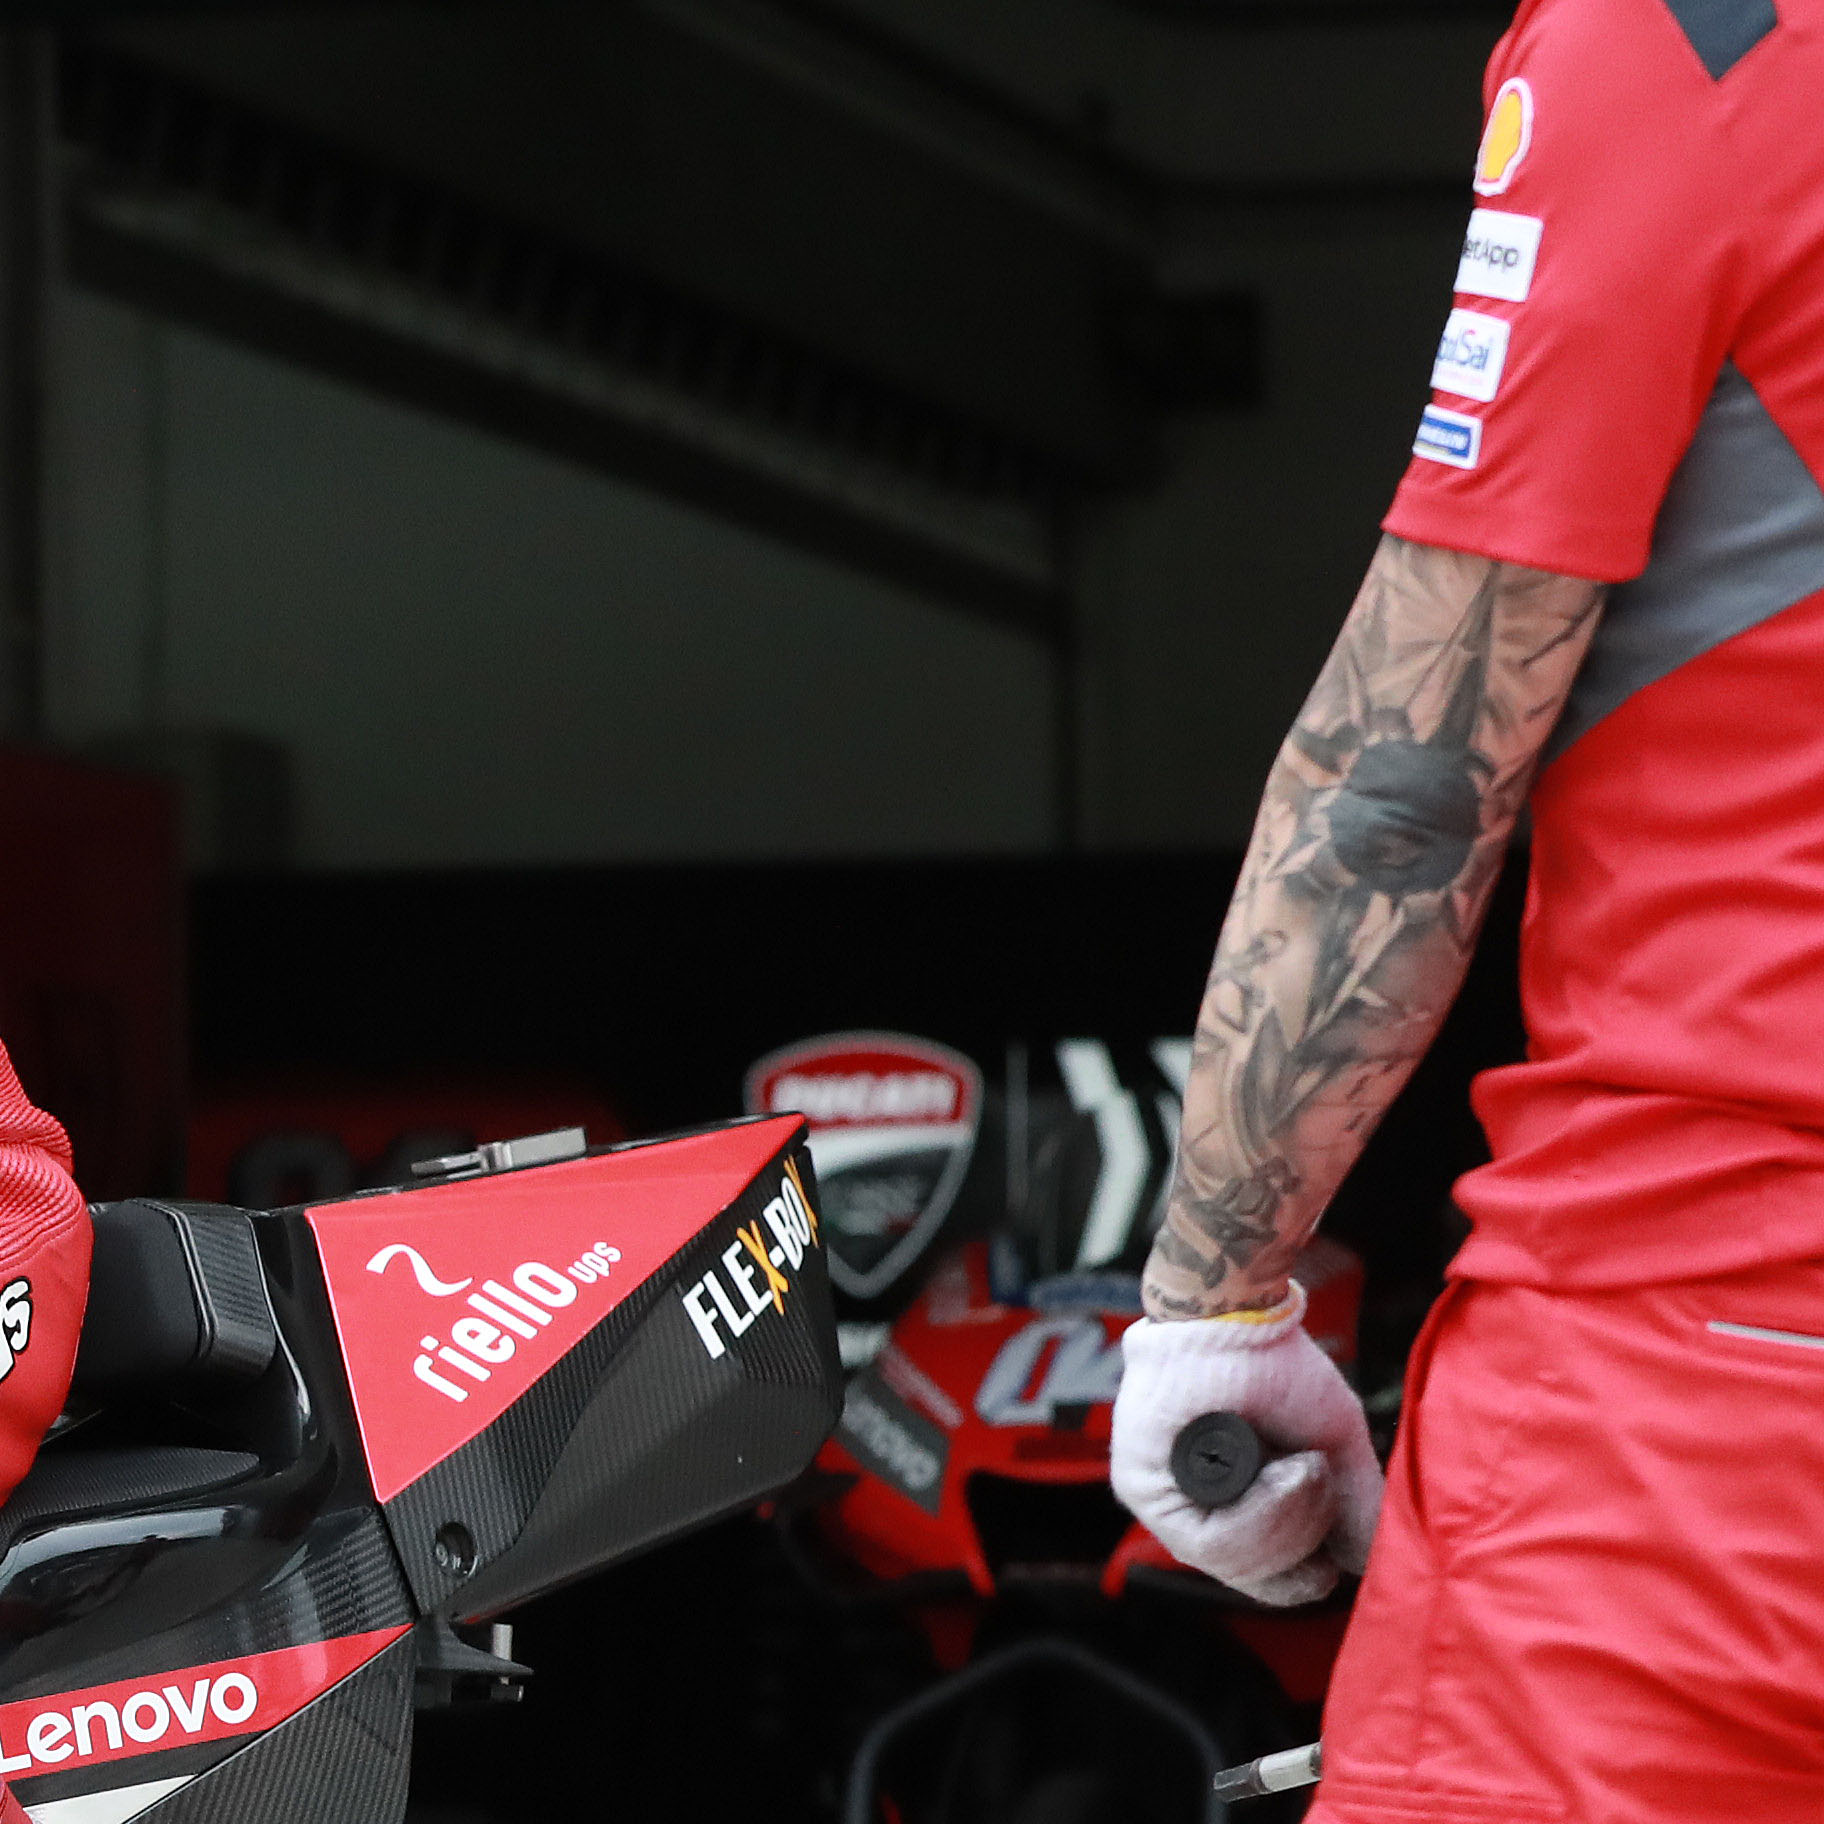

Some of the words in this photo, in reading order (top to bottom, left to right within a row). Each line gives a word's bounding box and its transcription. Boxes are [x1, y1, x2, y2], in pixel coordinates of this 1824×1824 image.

[413, 1259, 577, 1402] riello
[571, 1238, 621, 1286] ups
[682, 1156, 819, 1361] FLEX-BOX
